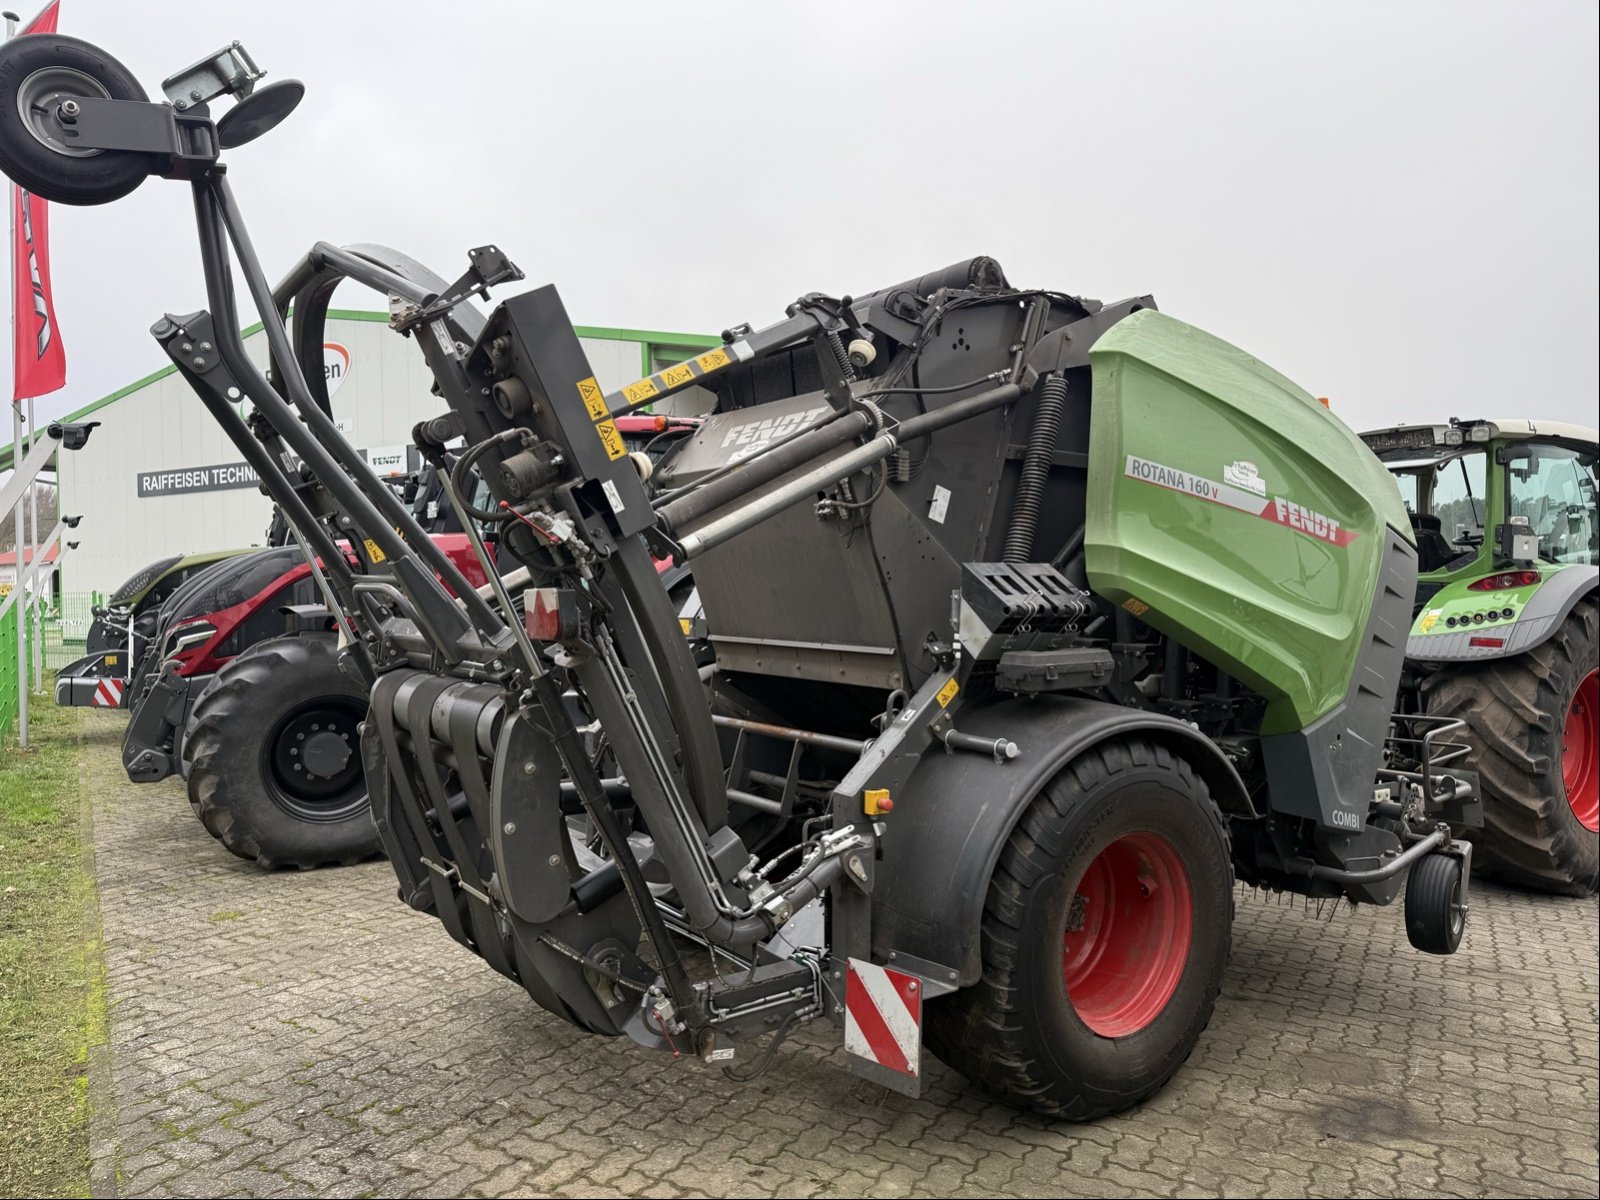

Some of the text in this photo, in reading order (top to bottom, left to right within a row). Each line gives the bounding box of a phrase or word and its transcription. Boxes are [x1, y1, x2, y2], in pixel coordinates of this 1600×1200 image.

[720, 406, 828, 449] FENDT
[372, 455, 402, 465] FENDT
[143, 466, 260, 491] RAIFFEISEN TECHNI
[1132, 459, 1185, 489] ROTANA
[1189, 477, 1210, 496] 160
[1274, 495, 1340, 542] FENDT
[1332, 810, 1360, 829] COMBI
